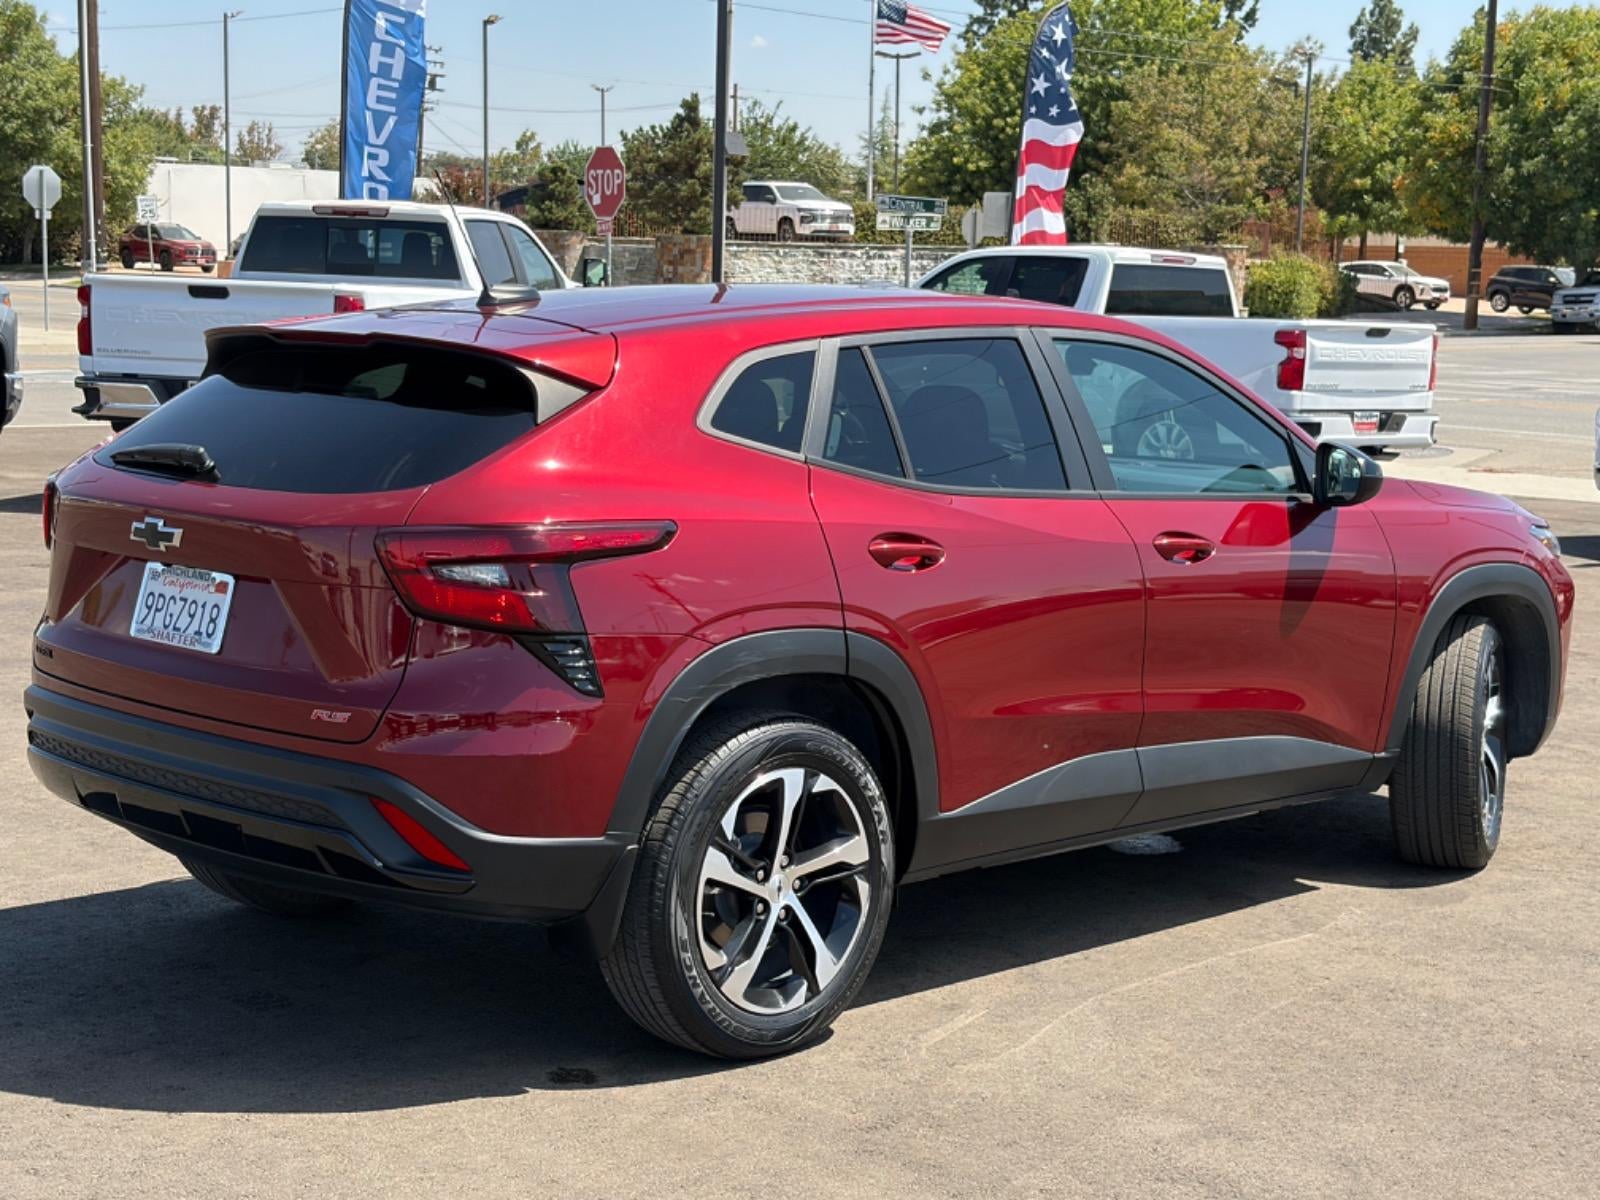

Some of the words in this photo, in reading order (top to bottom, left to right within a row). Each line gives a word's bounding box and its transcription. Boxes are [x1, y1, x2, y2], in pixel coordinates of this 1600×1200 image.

[588, 169, 622, 196] STOP
[141, 208, 156, 218] 25
[1319, 348, 1427, 361] CHEVROLET
[140, 591, 221, 639] 9PGZ918
[151, 629, 197, 648] SHAFTER
